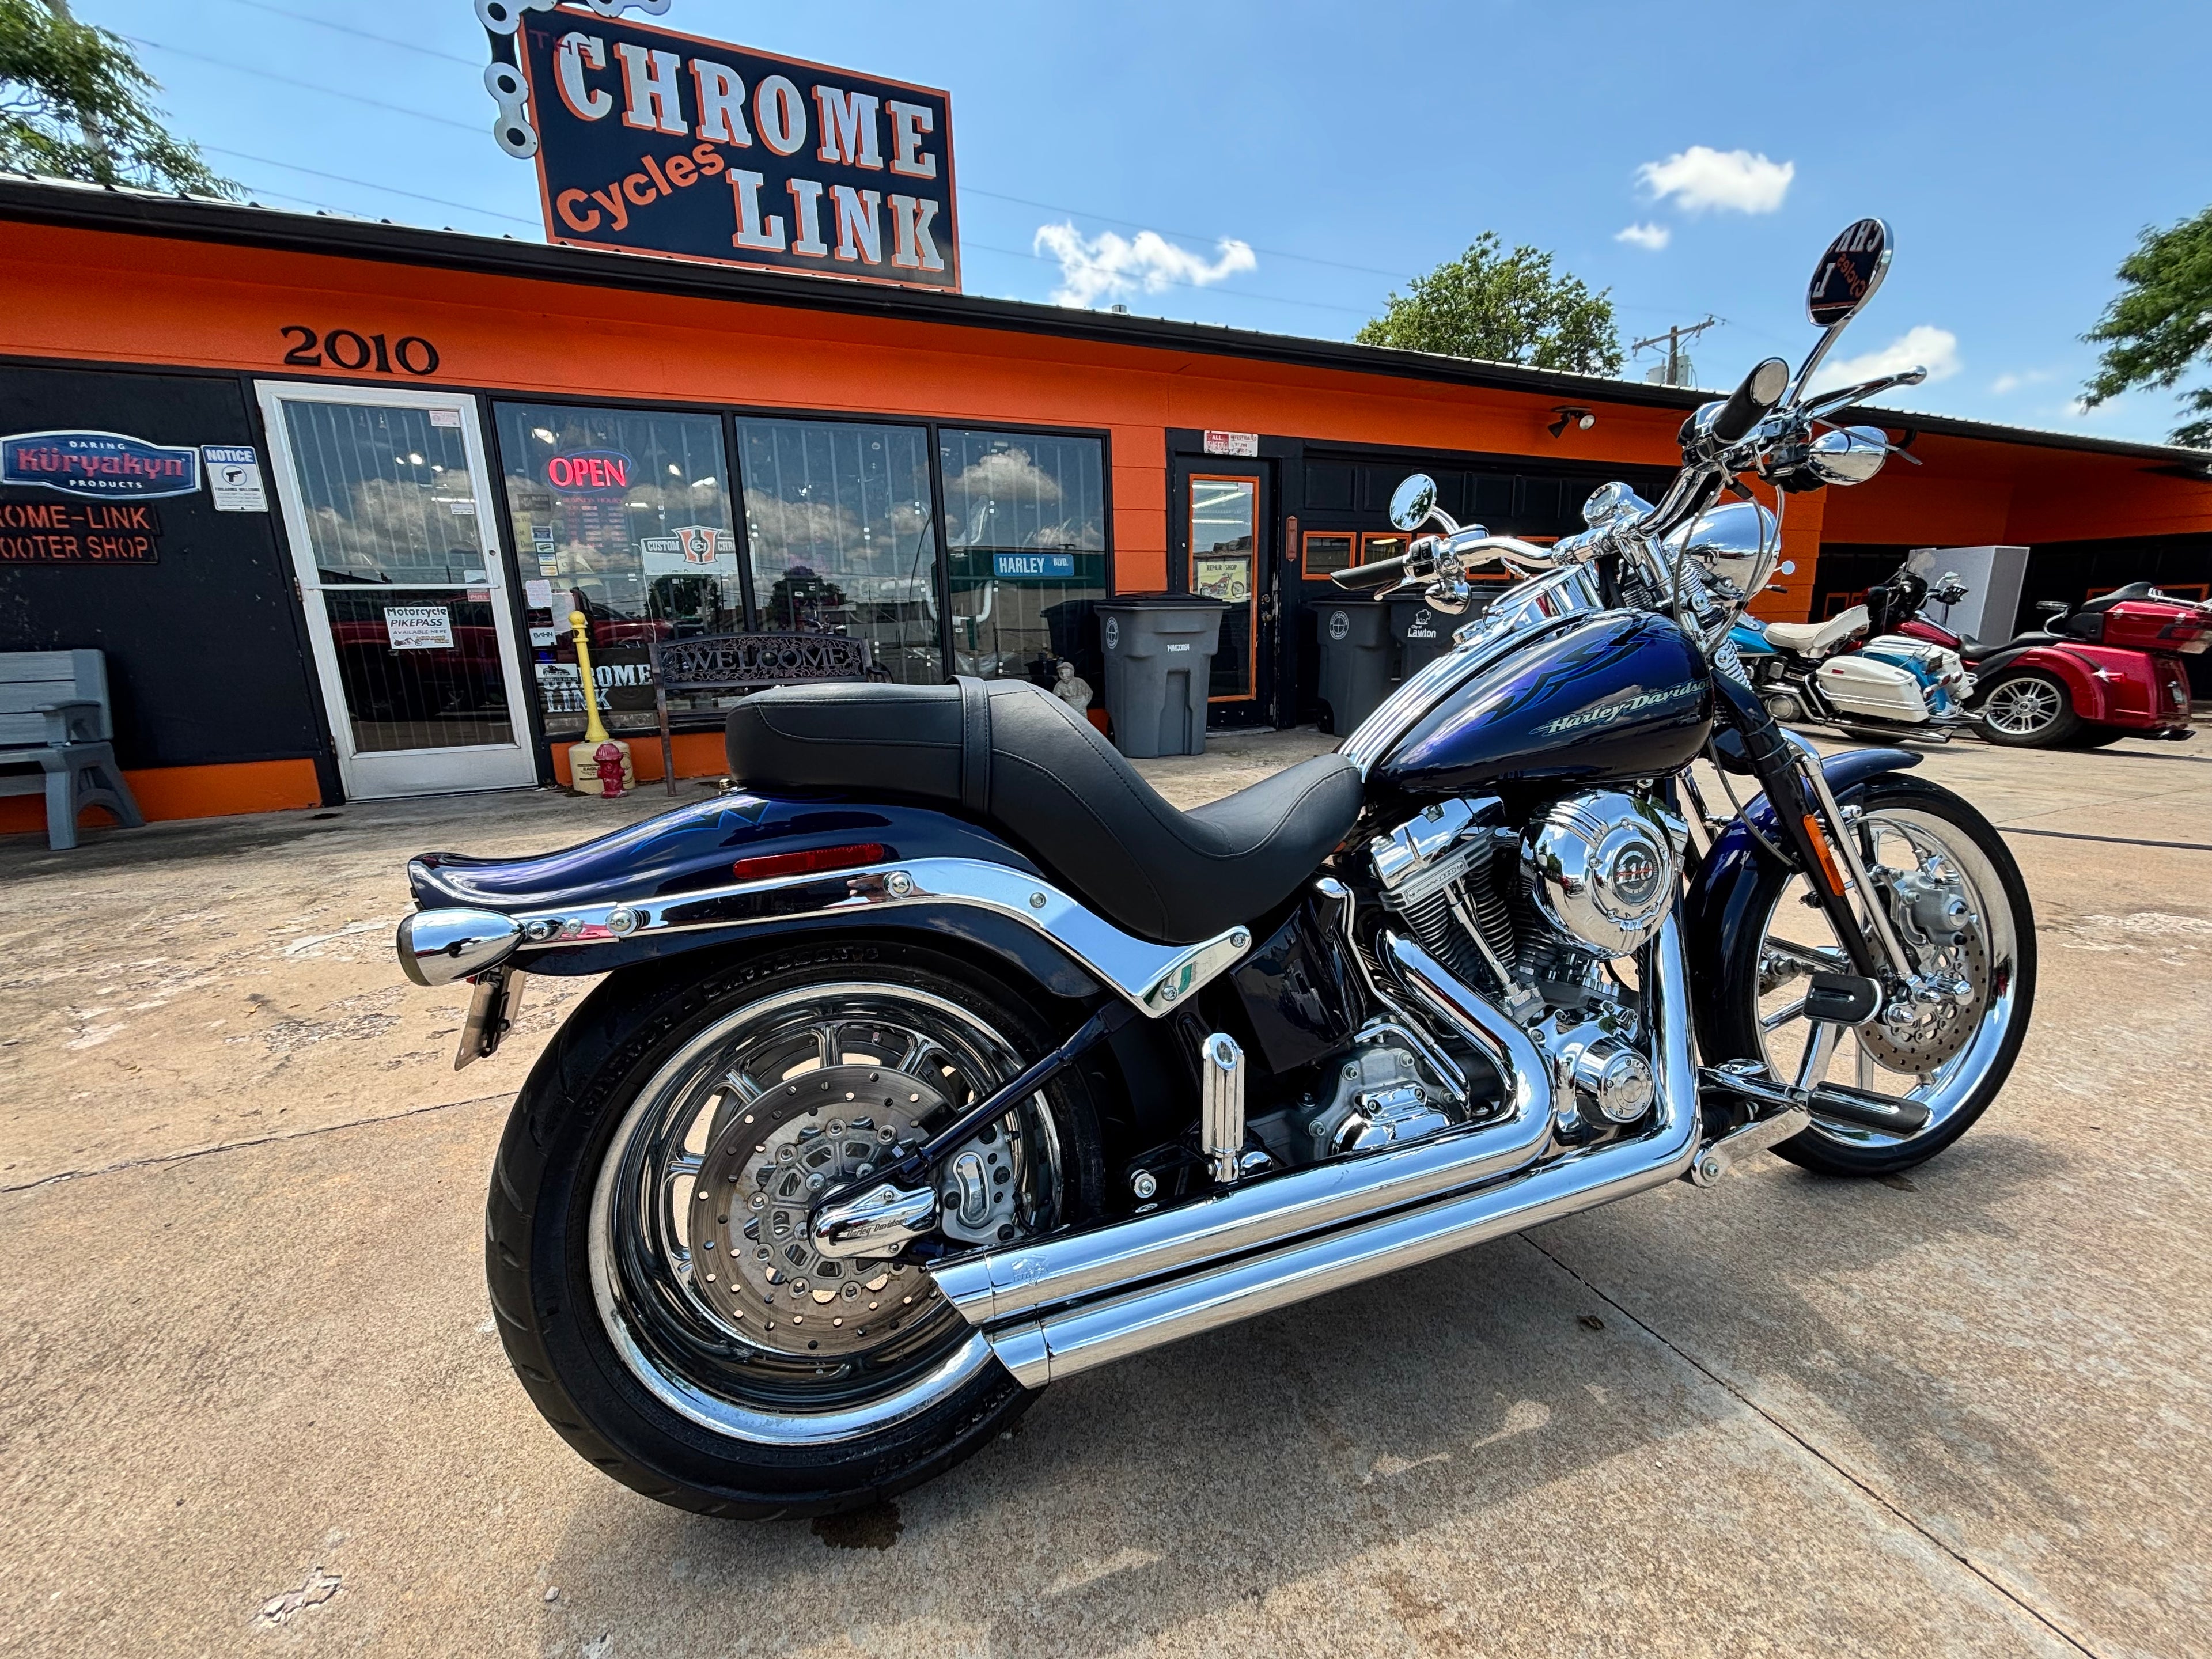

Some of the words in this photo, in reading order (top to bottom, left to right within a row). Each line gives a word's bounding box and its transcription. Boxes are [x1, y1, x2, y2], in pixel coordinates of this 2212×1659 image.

[554, 32, 937, 179] CHROME
[556, 142, 725, 232] Cycles
[725, 167, 945, 272] LINK
[281, 325, 439, 375] 2010
[69, 441, 126, 450] DARING
[206, 449, 253, 462] NOTICE
[17, 447, 184, 479] Küryakyn
[549, 457, 626, 486] OPEN
[69, 480, 143, 488] PRODUCTS
[88, 536, 148, 558] SHOP
[647, 541, 680, 551] CUSTOM
[999, 557, 1044, 573] HARLEY
[1053, 558, 1069, 566] BLVD.
[387, 608, 446, 618] Motorcycle
[391, 619, 442, 627] PIKEPASS
[1407, 627, 1437, 638] Lawton
[680, 647, 846, 672] WELCOME
[1539, 678, 1713, 734] Harley-Davidson
[1438, 867, 1457, 882] 110
[1615, 860, 1653, 884] 110
[847, 1217, 908, 1238] Harley-Davidson
